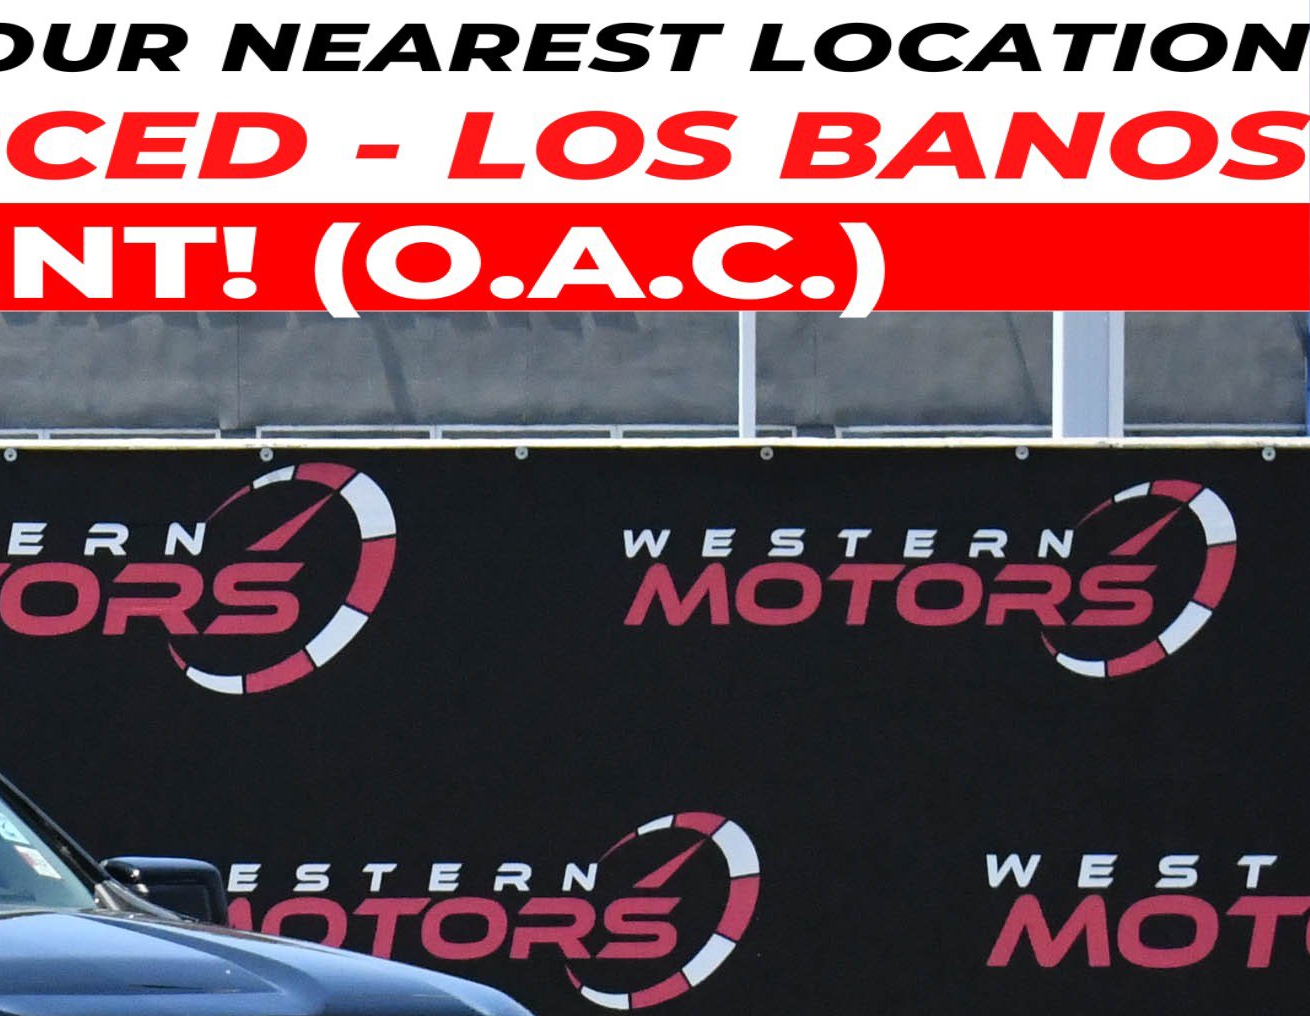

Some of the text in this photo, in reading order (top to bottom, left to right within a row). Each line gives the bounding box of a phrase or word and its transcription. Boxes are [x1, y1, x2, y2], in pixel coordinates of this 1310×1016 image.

[623, 529, 1074, 558] WESTERN
[624, 562, 1157, 627] MOTORS
[986, 894, 1310, 969] MOT
